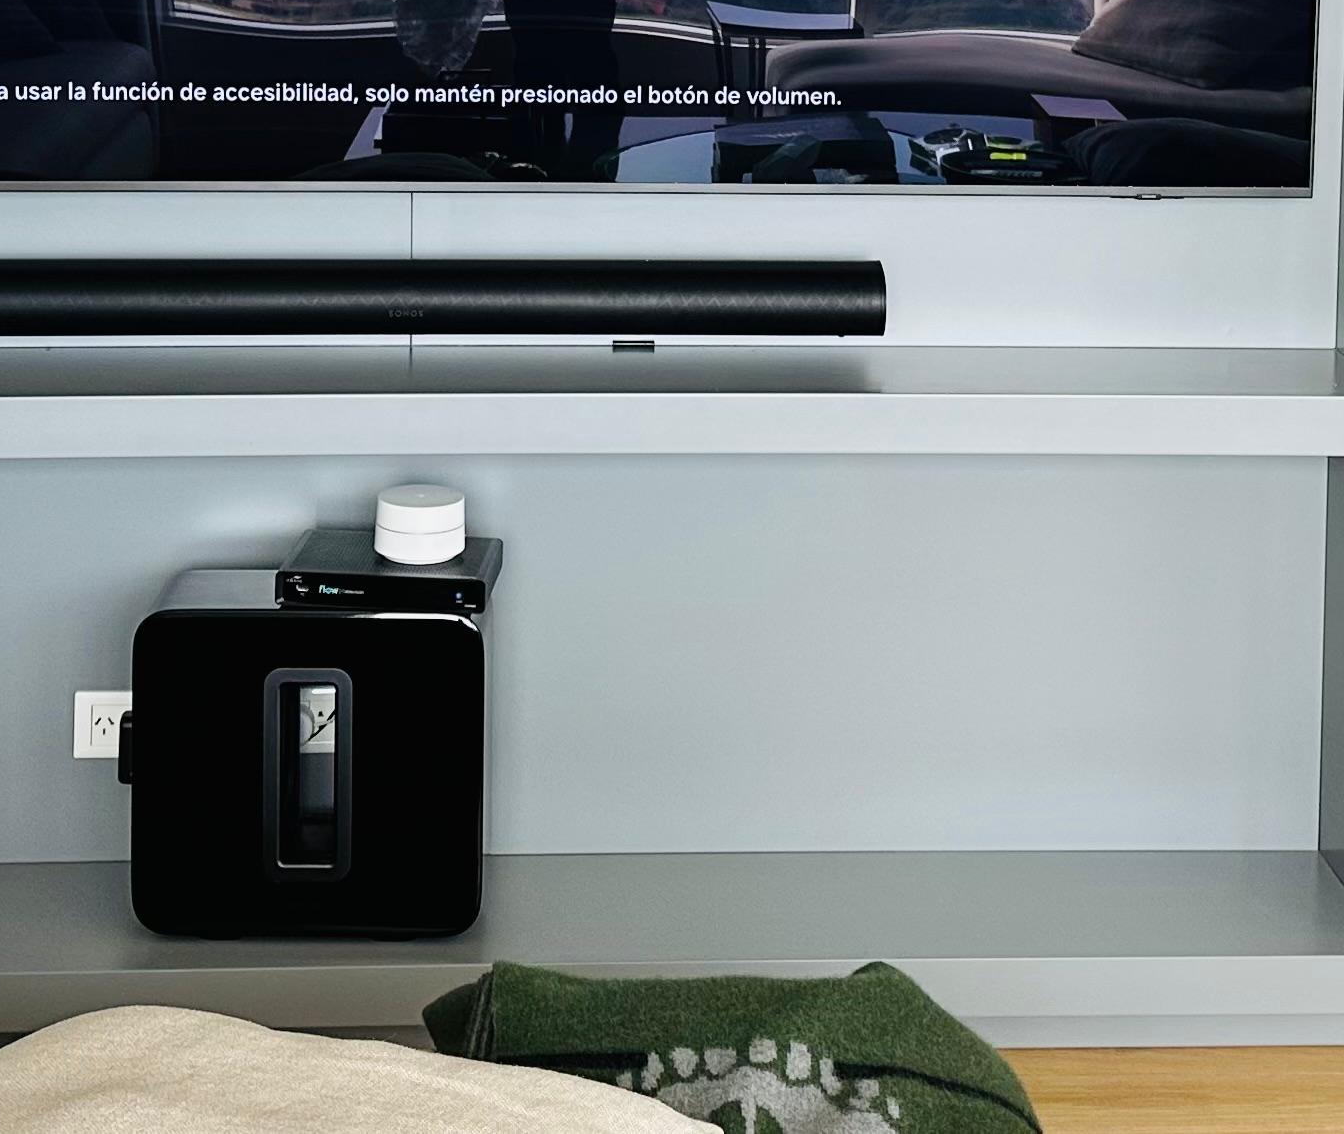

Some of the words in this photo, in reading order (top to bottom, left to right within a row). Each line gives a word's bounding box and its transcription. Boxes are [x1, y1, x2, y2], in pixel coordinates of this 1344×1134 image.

[15, 85, 62, 101] usar
[68, 82, 86, 101] la
[92, 80, 173, 101] función
[179, 82, 207, 101] de
[213, 82, 359, 105] accesibilidad,
[365, 84, 409, 103] solo
[415, 83, 495, 103] mantén
[502, 84, 618, 107] presionado
[623, 84, 642, 104] el
[649, 84, 708, 105] botón
[714, 85, 741, 105] de
[747, 86, 842, 106] volumen.
